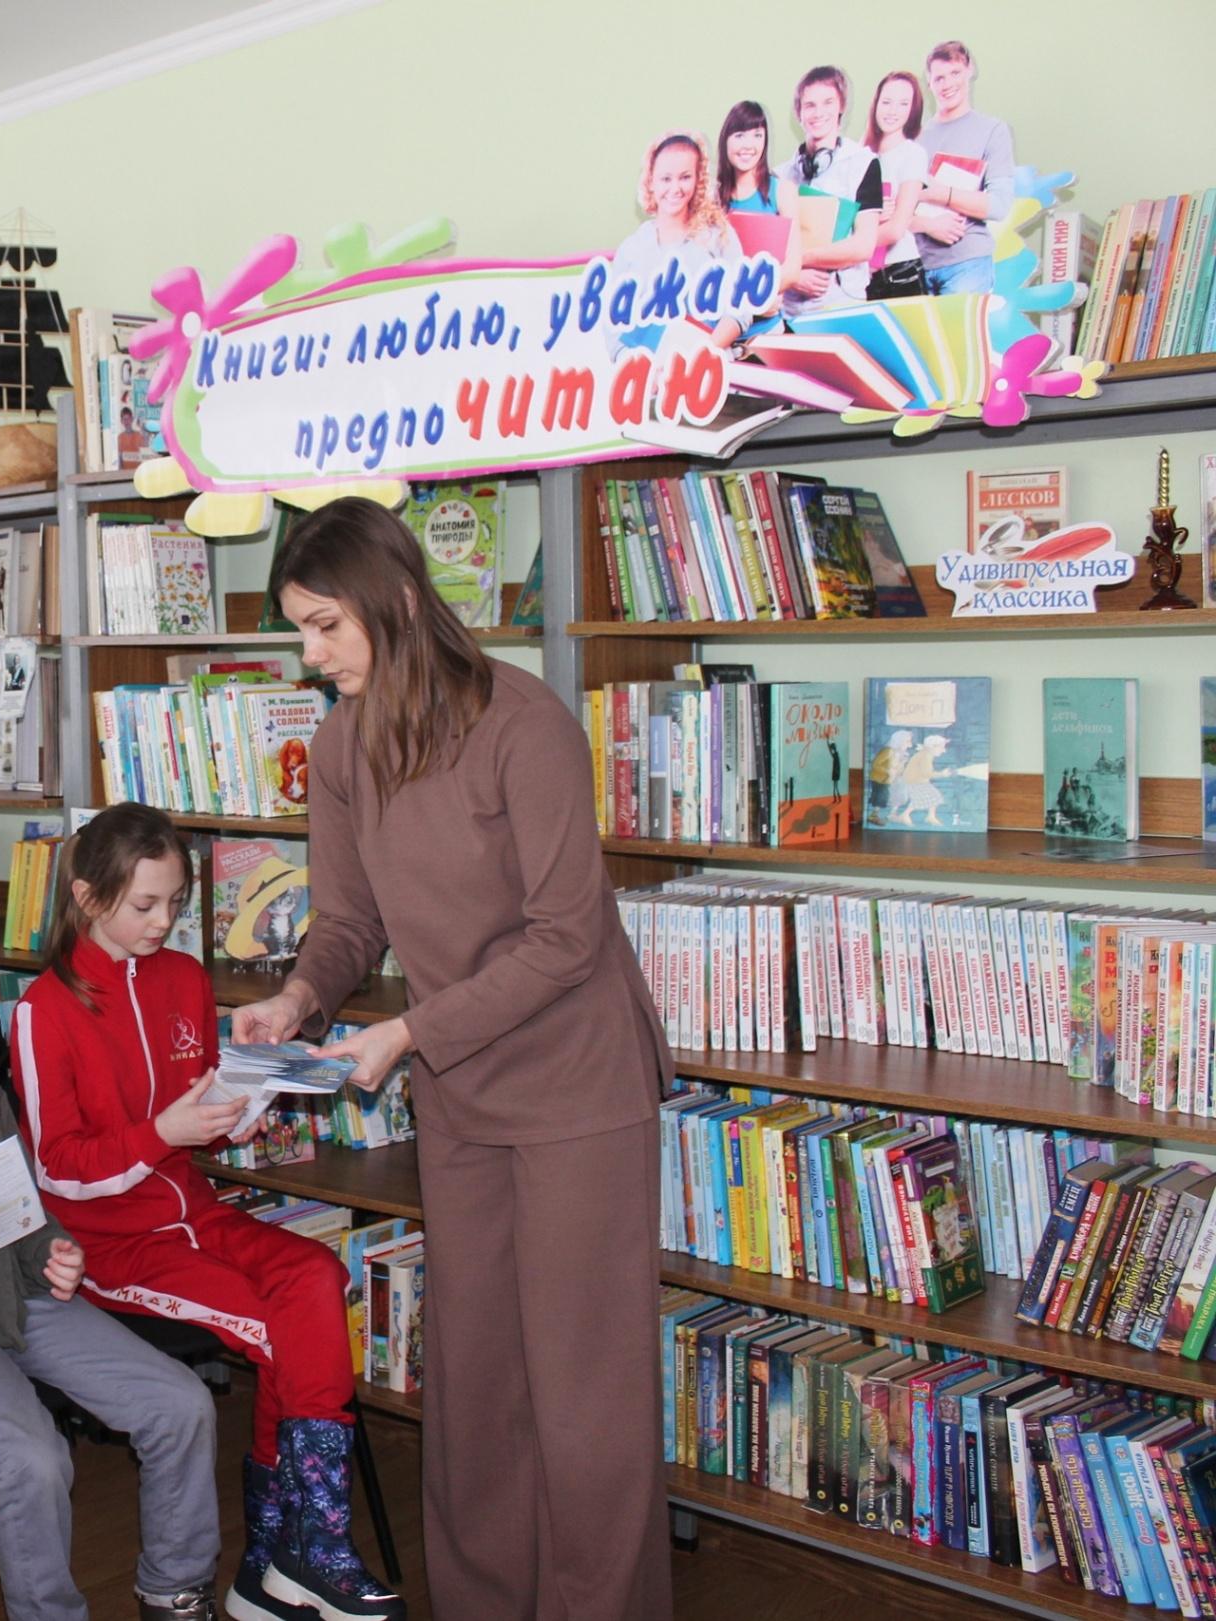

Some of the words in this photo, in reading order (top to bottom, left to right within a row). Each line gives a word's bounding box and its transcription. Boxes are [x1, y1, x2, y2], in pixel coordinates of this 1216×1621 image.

[196, 332, 331, 388] Книги:
[347, 290, 521, 364] люблю,
[543, 257, 775, 351] уважаю
[982, 489, 1057, 508] ЛЕСКОВ
[430, 519, 476, 532] АНАТОМИЯ
[431, 531, 473, 543] ПРИРОДЫ
[151, 537, 203, 549] Растения
[940, 555, 1129, 588] Удивительная
[268, 706, 316, 717] КЛАДОВАЯ
[276, 716, 311, 726] СОЛНЦА
[1200, 998, 1208, 1044] ОТВАЖНЫЕ
[1199, 1046, 1207, 1092] КАПИТАНЫ
[897, 1183, 909, 1222] БУЛЫЧЕВ
[1063, 1184, 1081, 1211] ЕМЕЦ
[1143, 1290, 1166, 1317] Таня
[752, 1434, 758, 1443] НА
